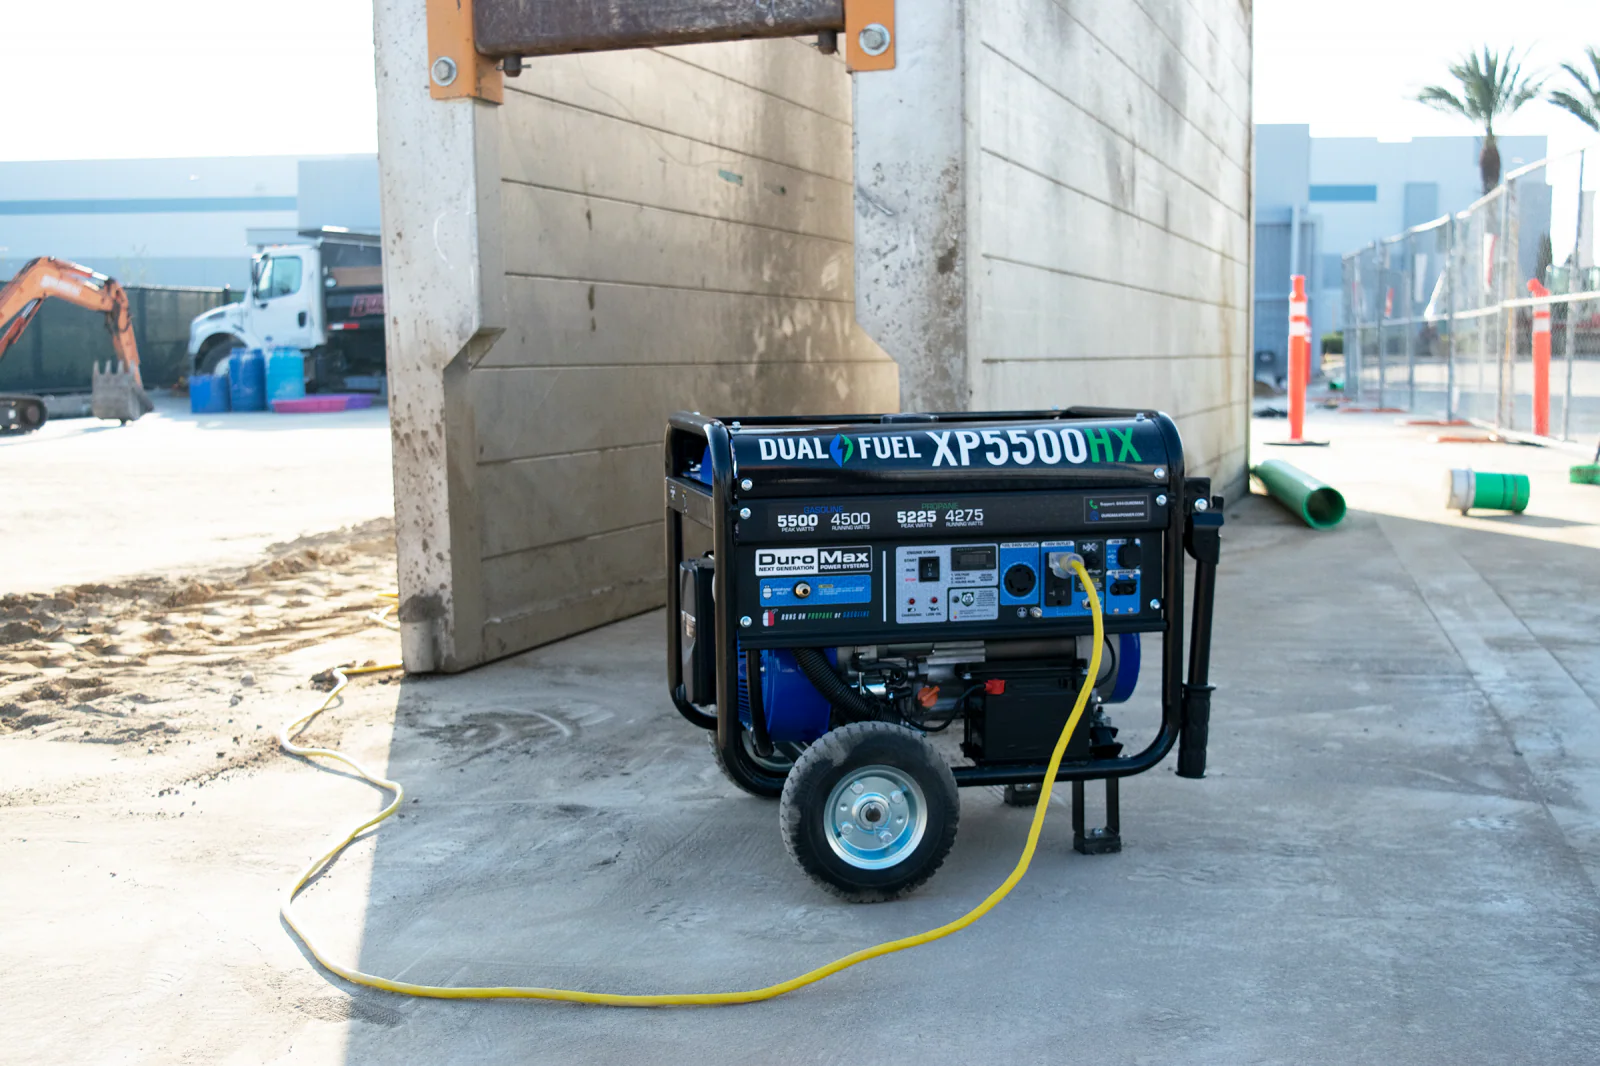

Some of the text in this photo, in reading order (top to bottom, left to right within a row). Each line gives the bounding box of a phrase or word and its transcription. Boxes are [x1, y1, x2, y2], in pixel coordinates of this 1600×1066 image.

[758, 427, 1142, 467] DUAL FUEL XP5500HX
[803, 505, 844, 514] GASOLINE
[921, 502, 959, 510] PROPANE
[777, 512, 871, 527] 5500 4500
[897, 508, 984, 523] 5225 4275
[759, 550, 869, 565] Duro Max
[781, 613, 797, 621] RUNS
[798, 612, 807, 620] ON
[807, 612, 833, 620] PROPANE
